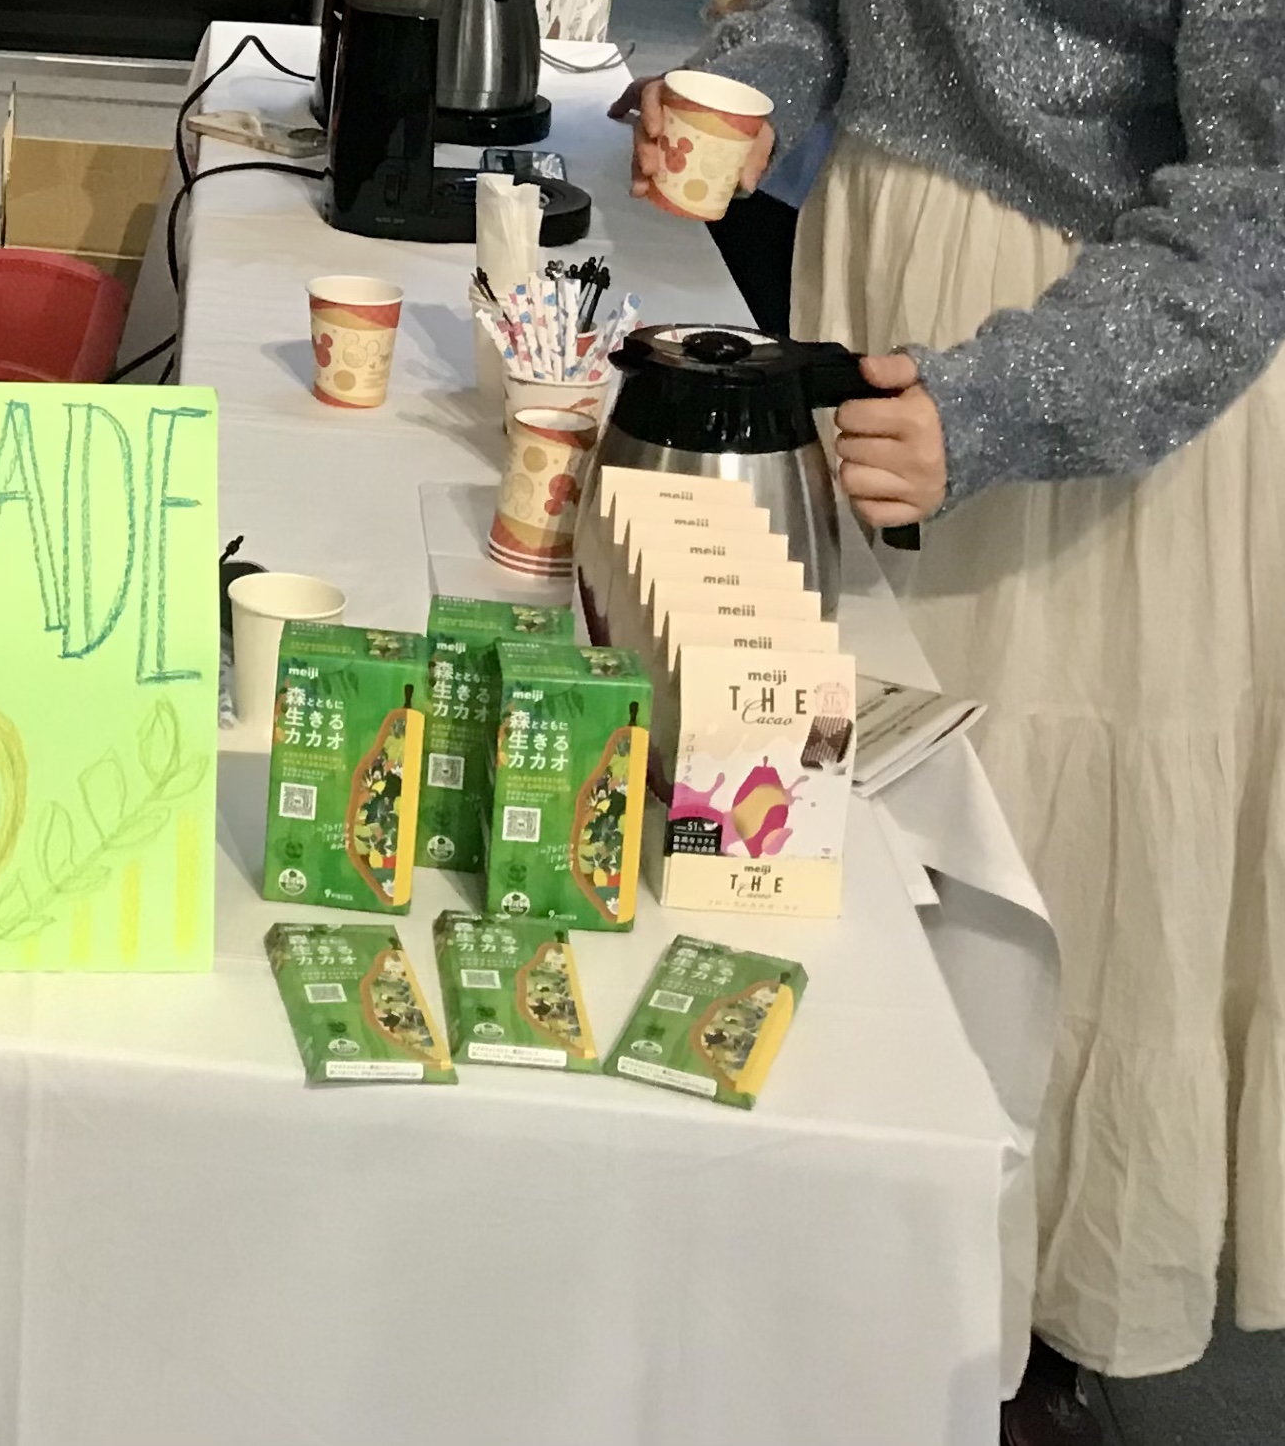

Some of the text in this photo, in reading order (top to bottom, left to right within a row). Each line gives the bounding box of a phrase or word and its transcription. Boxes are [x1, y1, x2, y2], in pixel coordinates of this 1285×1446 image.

[437, 642, 466, 654] meiji
[288, 667, 319, 679] meiji
[433, 661, 490, 683] 森とともに
[747, 670, 787, 685] meiji
[286, 687, 344, 710] 森とともに
[432, 680, 490, 702] 生きる
[513, 690, 544, 702] meiji
[729, 685, 807, 715] THE
[284, 707, 344, 730] 生きる
[432, 701, 490, 723] カカオ
[509, 710, 569, 731] 森とともに
[741, 698, 793, 726] Cacao
[284, 728, 344, 750] カカオ
[508, 730, 569, 751] 生きる
[508, 751, 569, 771] カカオ
[744, 865, 772, 876] meiji
[730, 874, 783, 893] THE
